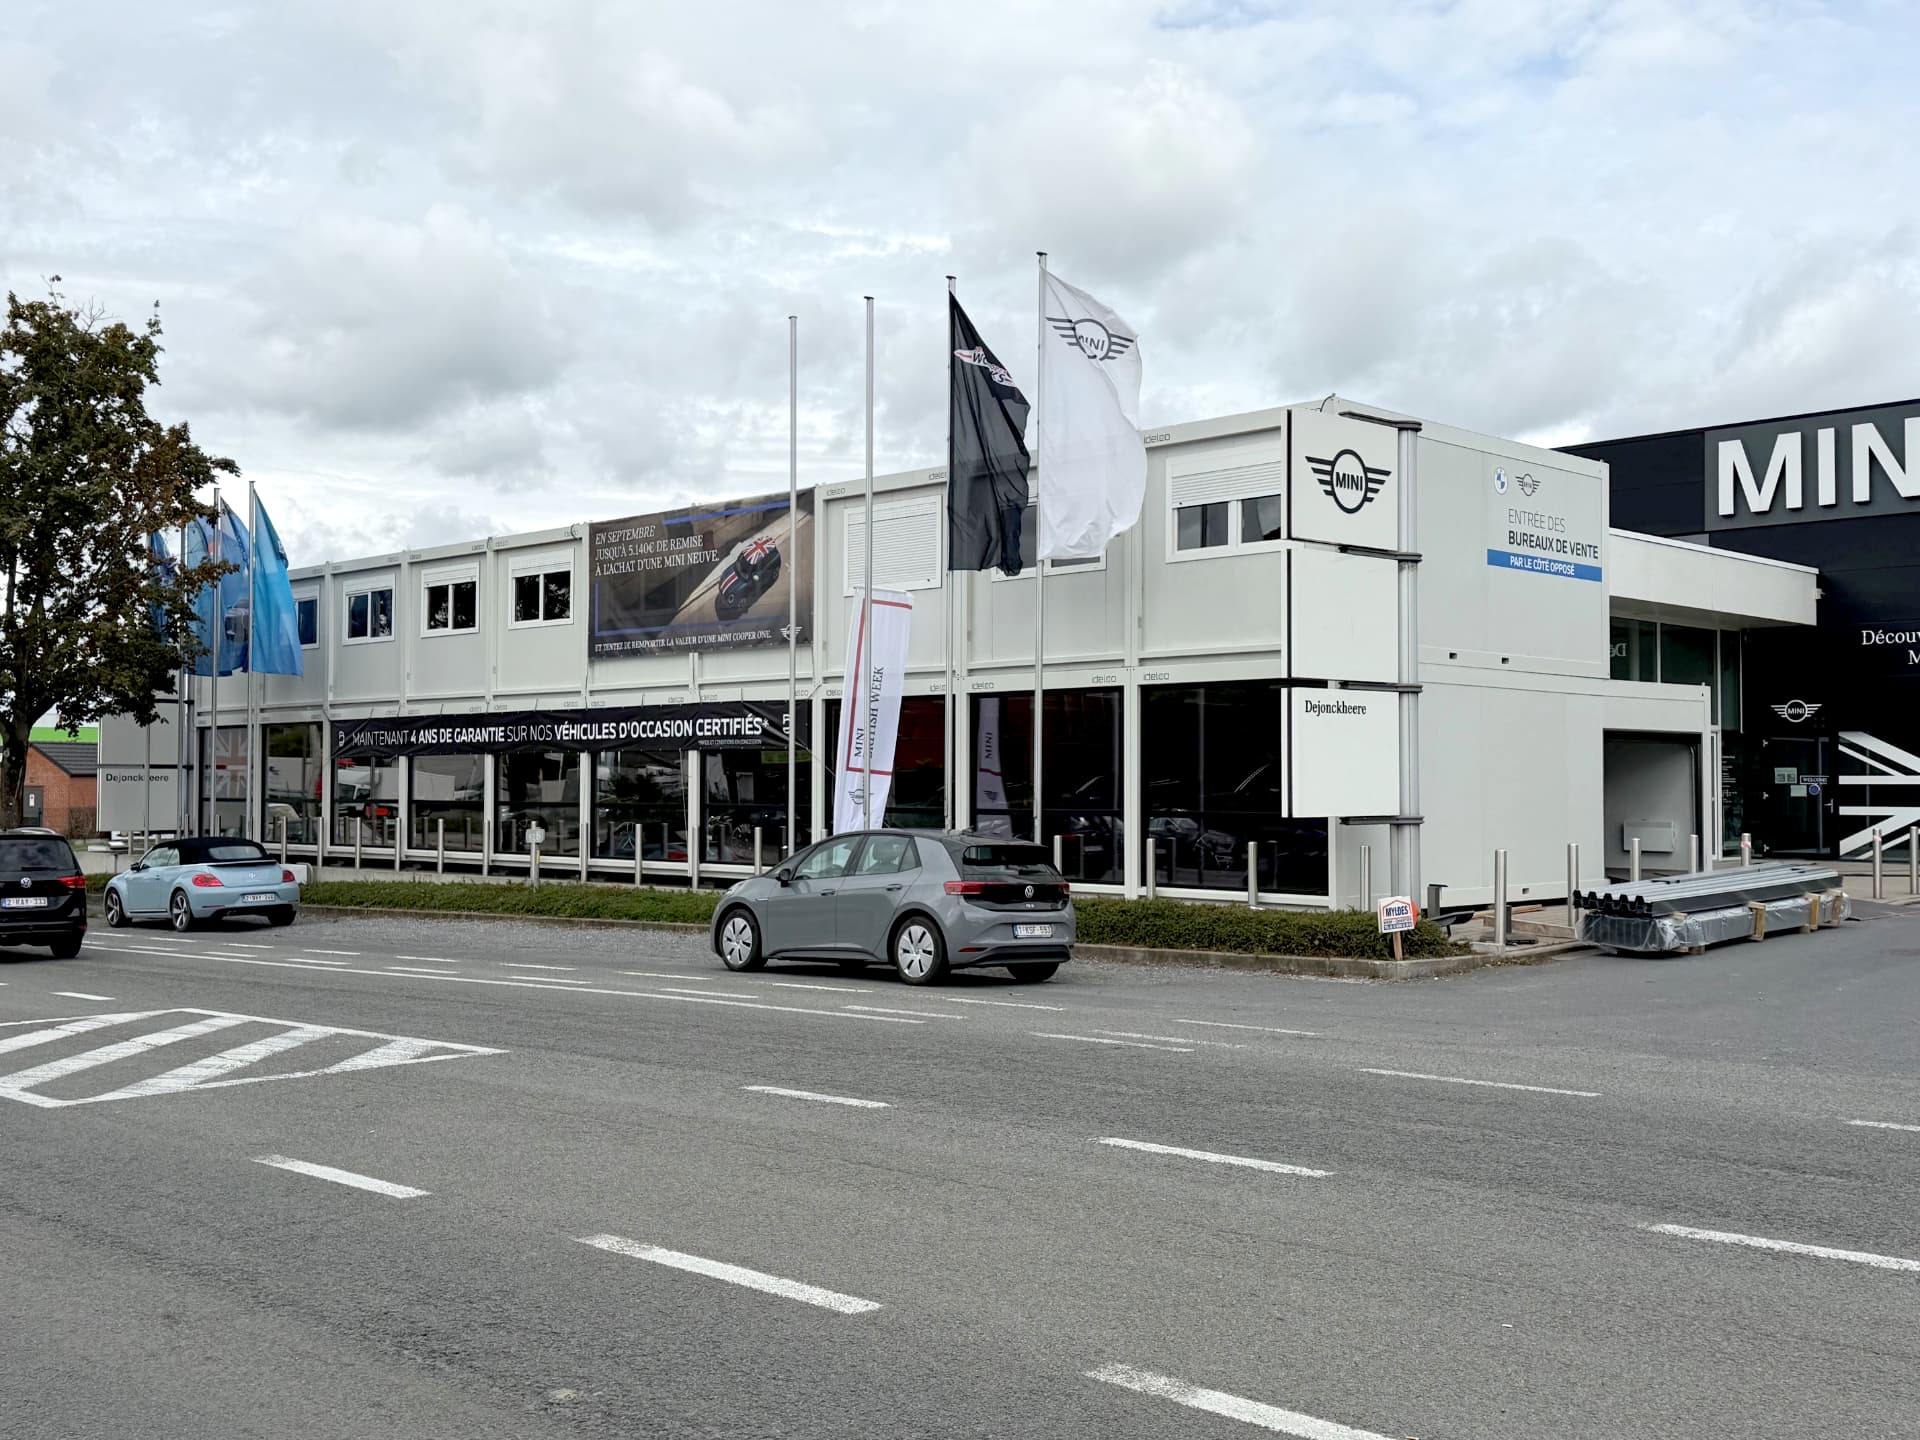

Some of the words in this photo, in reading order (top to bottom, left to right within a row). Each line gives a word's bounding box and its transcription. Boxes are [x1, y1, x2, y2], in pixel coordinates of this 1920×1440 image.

[1335, 471, 1363, 492] MINI
[1508, 508, 1546, 530] ENTRÉE
[1548, 515, 1566, 533] DES
[595, 533, 607, 545] EN
[607, 525, 656, 543] SEPTEMBRE
[1508, 530, 1554, 552] BUREAUX
[1556, 538, 1568, 555] DE
[1569, 540, 1599, 560] VENTE
[595, 543, 627, 560] JUSQU'À
[628, 541, 655, 557] 5.140€
[656, 540, 669, 553] DE
[670, 535, 704, 551] REMISE
[595, 562, 602, 577] À
[603, 560, 636, 576] L'ACHAT
[637, 558, 663, 571] D'UNE
[664, 554, 685, 568] MINI
[687, 549, 720, 565] NEUVE.
[1510, 555, 1522, 568] PAR
[1523, 557, 1533, 569] LE
[1533, 557, 1550, 572] CÔTÉ
[1550, 561, 1575, 576] OPPOSÉ
[666, 637, 675, 647] LA
[675, 635, 697, 646] VALEUR
[698, 634, 717, 644] D'UNE
[718, 632, 732, 643] MINI
[732, 631, 757, 641] COOPER
[870, 667, 885, 703] WEEK
[1305, 699, 1367, 717] Dejonckheere
[1787, 707, 1805, 715] MINI
[352, 730, 409, 746] MAINTENANT
[410, 729, 417, 744] 4
[418, 728, 438, 744] ANS
[439, 727, 453, 743] DE
[454, 726, 505, 743] GARANTIE
[507, 725, 528, 742] SUR
[529, 724, 552, 741] NOS
[554, 721, 617, 741] VÉHICULES
[619, 719, 693, 739] D'OCCASION
[854, 728, 865, 758] MINI
[105, 773, 169, 783] Dejonckeere
[1385, 905, 1409, 917] MYLDES
